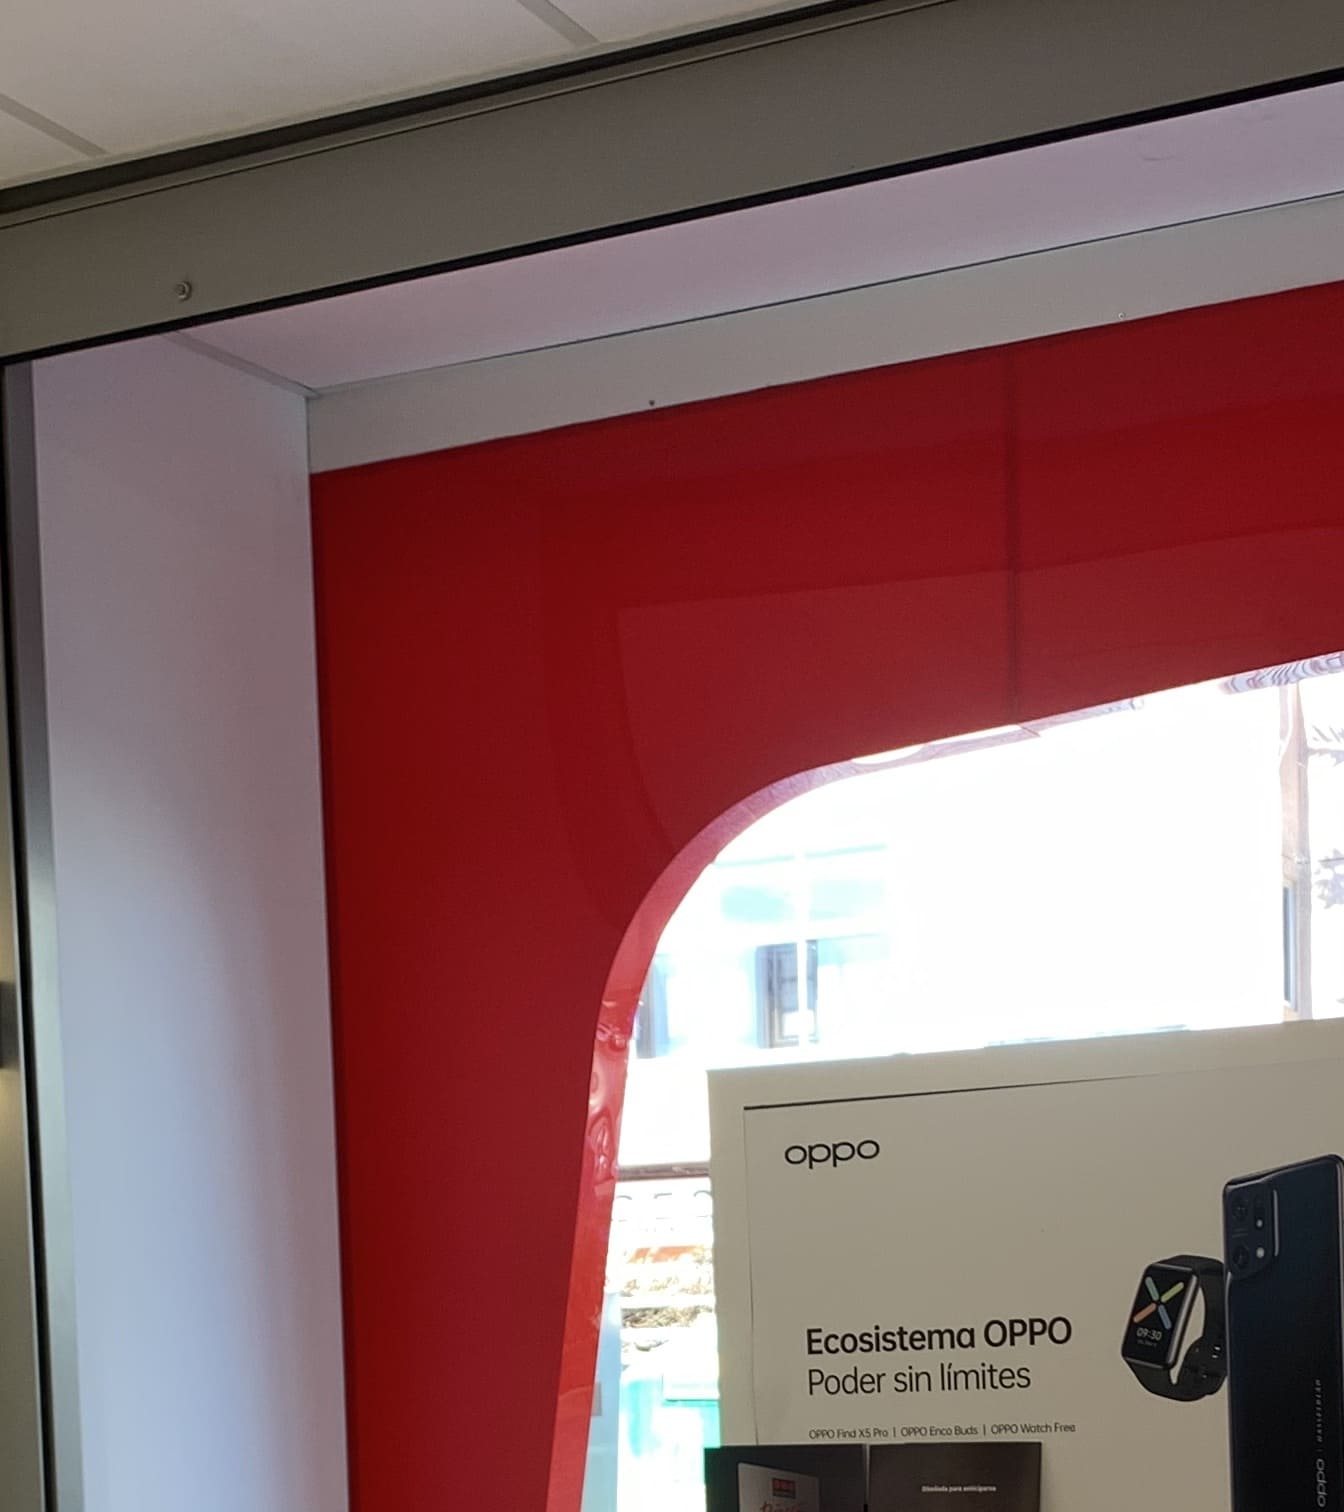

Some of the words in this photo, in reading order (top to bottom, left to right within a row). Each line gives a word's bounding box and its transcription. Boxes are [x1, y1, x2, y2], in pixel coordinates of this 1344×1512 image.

[806, 1325, 976, 1355] Ecosistema
[983, 1316, 1073, 1348] OPPO
[808, 1365, 887, 1395] Poder
[893, 1365, 932, 1393] sin
[940, 1362, 1032, 1391] límites
[808, 1428, 835, 1440] OPPO
[900, 1426, 928, 1437] OPPO
[990, 1423, 1019, 1435] OPPO
